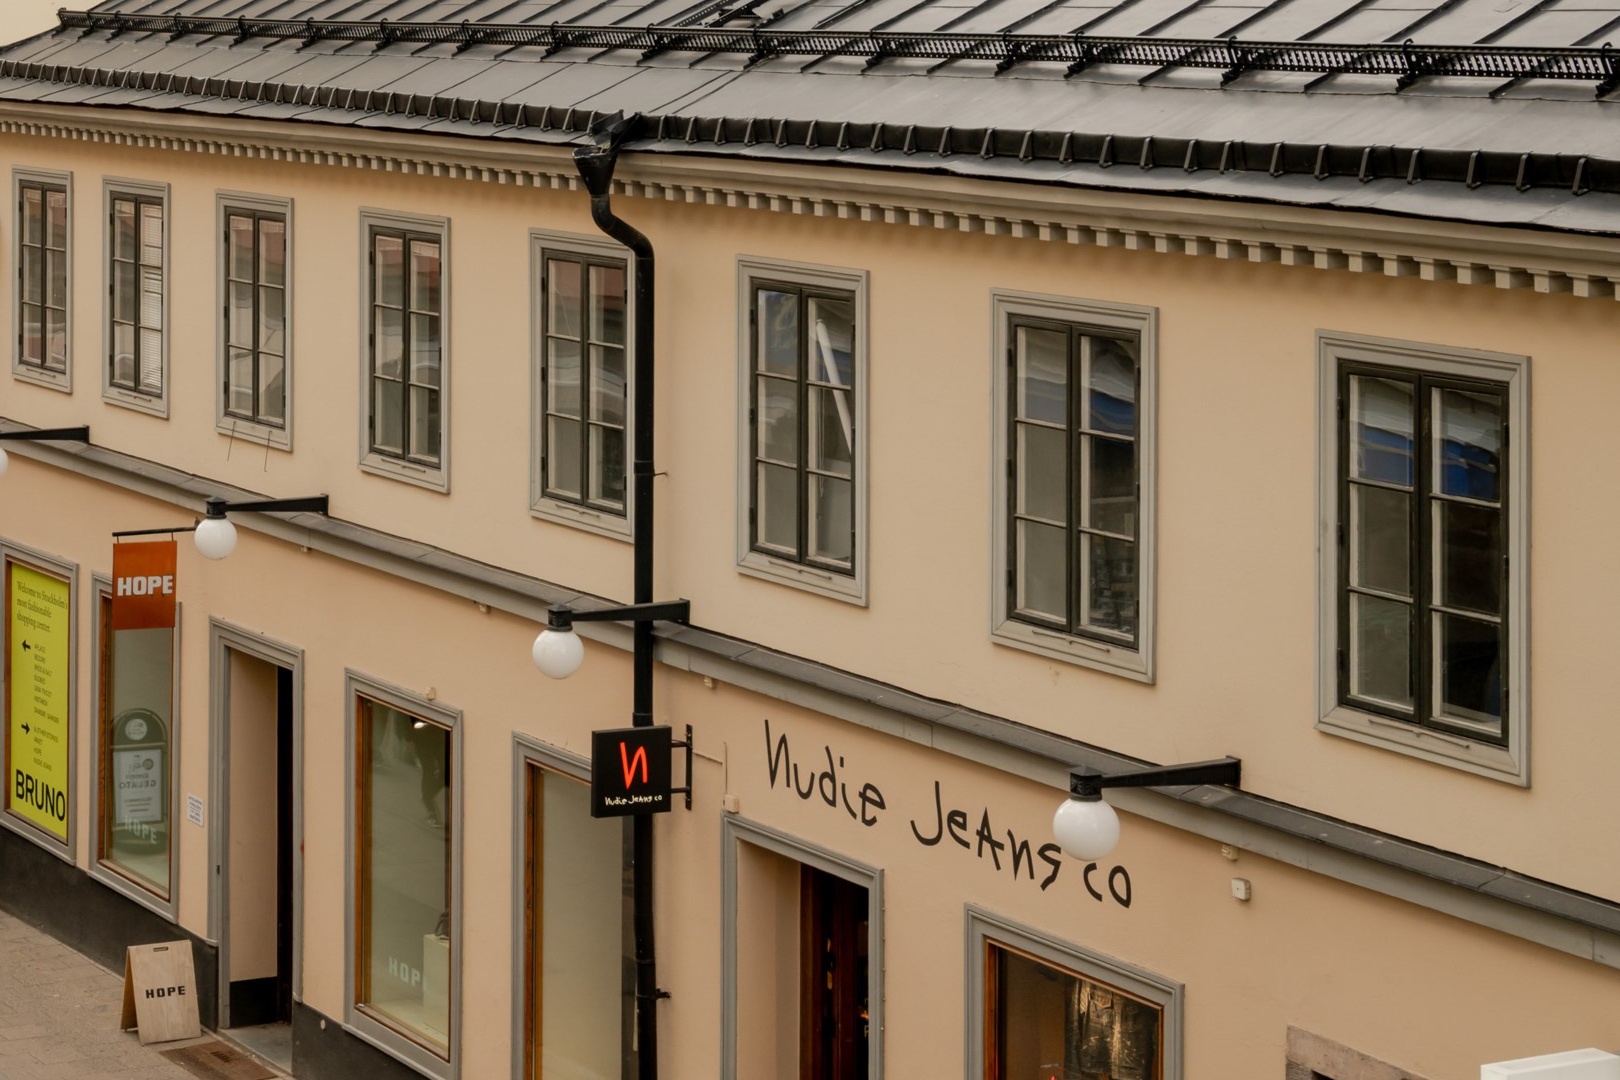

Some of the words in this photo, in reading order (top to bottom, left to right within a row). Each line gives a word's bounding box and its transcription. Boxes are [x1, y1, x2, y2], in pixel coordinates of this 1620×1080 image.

[17, 581, 36, 597] Welcome
[117, 575, 173, 596] HOPE
[16, 769, 66, 822] BRUNO
[124, 815, 157, 845] HOPE
[146, 985, 186, 999] HOPE
